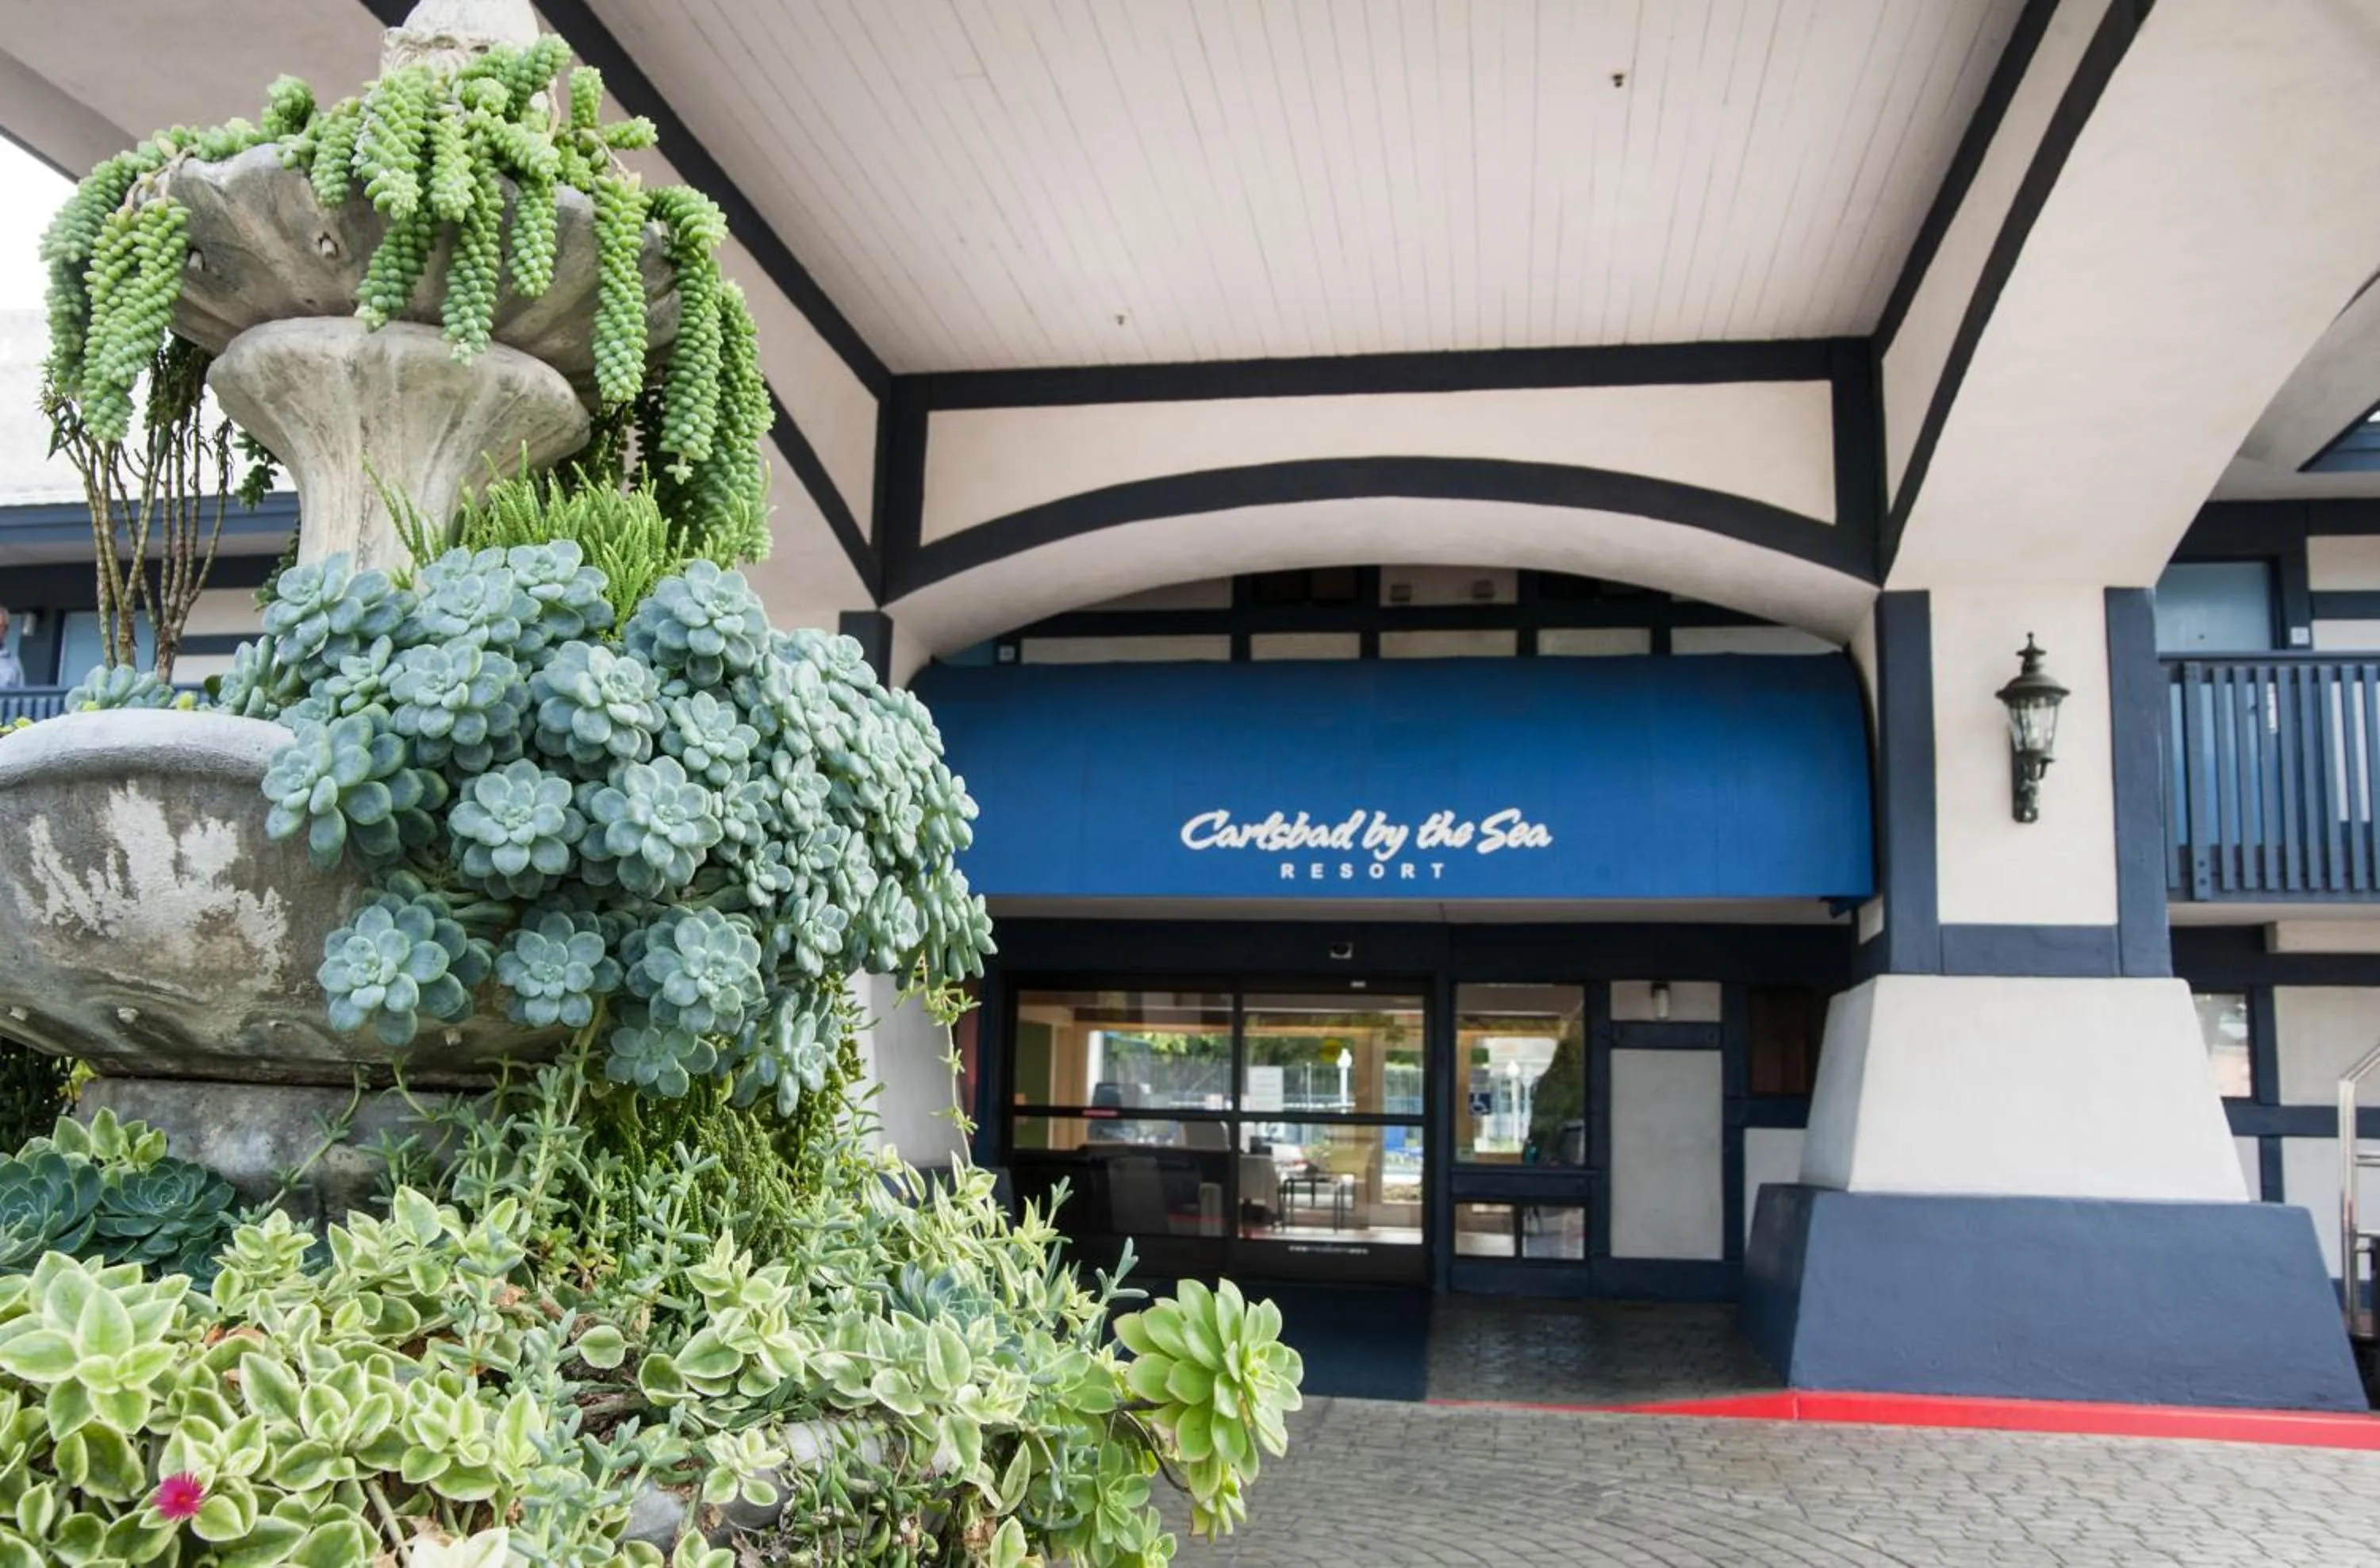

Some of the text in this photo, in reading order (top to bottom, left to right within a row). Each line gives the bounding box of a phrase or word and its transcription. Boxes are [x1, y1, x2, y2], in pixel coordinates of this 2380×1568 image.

[1180, 808, 1553, 861] Carlsbad by the Sea
[1280, 863, 1444, 878] RESORT
